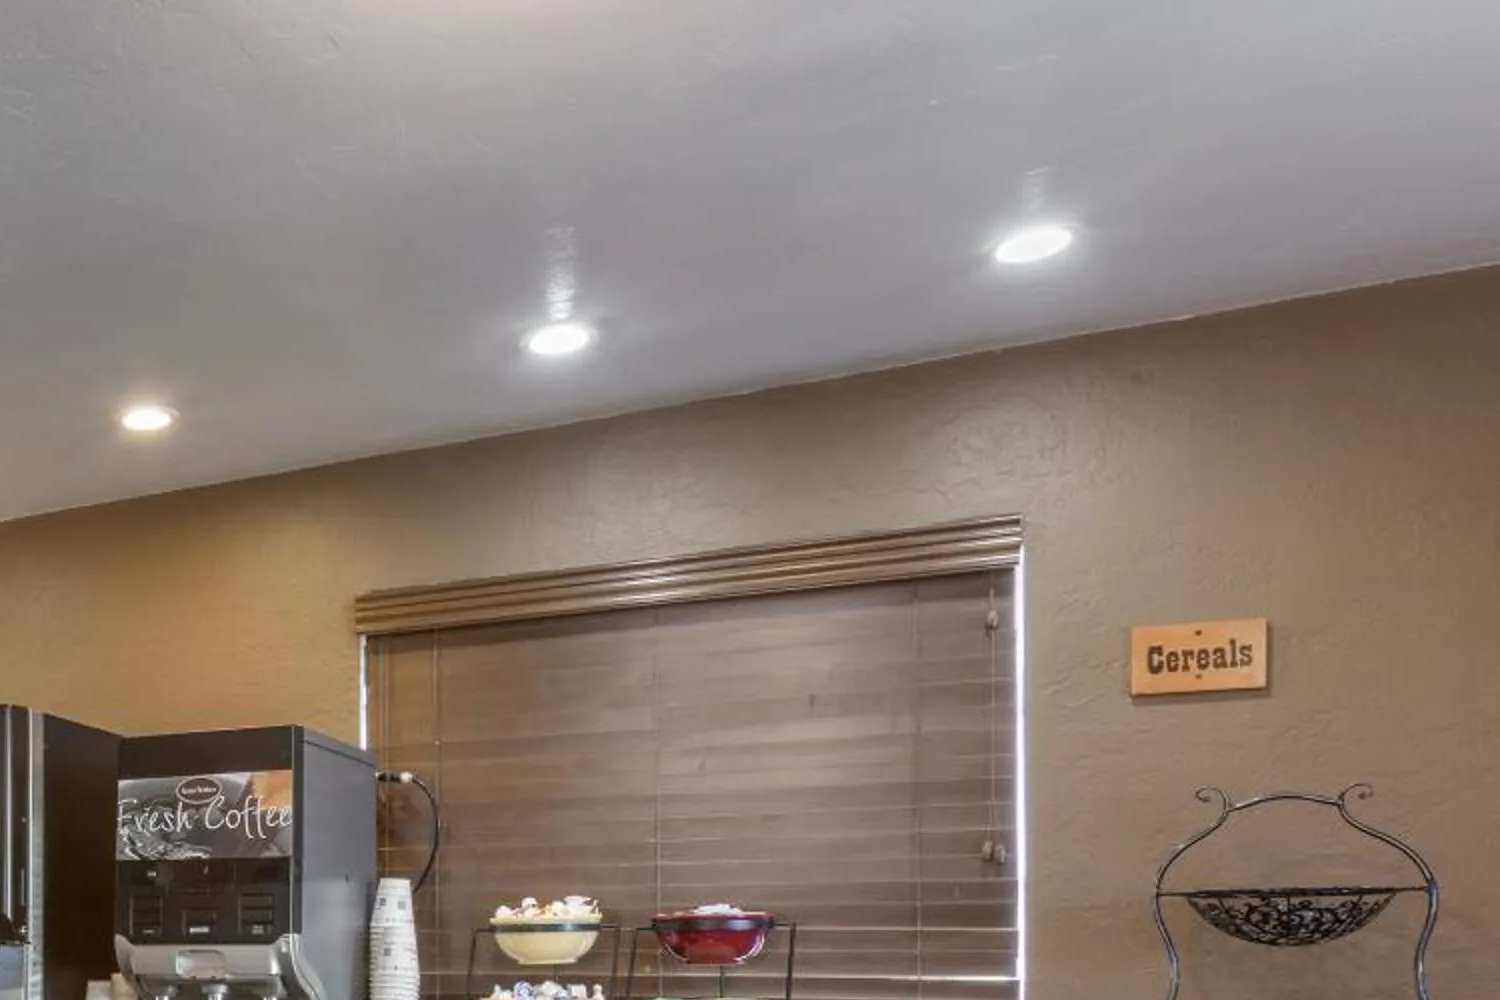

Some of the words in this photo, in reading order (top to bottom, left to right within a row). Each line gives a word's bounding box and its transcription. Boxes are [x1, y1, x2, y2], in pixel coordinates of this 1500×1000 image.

[1147, 637, 1253, 674] Cereals
[117, 798, 193, 834] Fresh
[204, 795, 293, 839] Coffee
